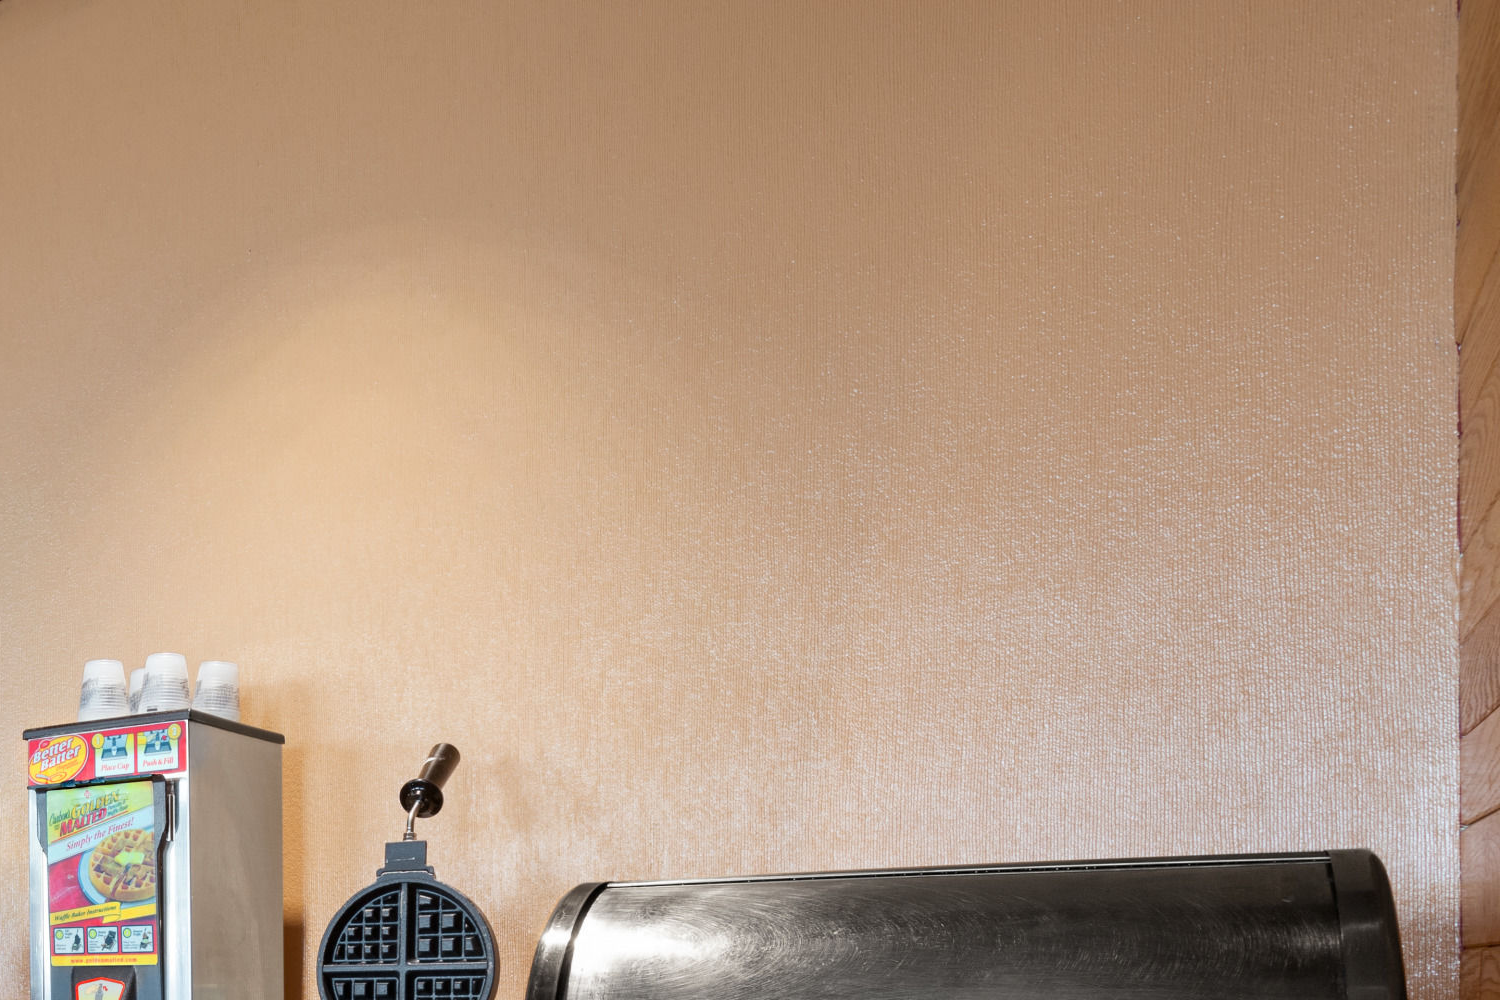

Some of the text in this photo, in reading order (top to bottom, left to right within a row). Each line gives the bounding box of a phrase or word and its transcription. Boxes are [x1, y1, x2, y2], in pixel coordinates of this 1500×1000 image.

[32, 737, 74, 765] Better
[40, 745, 81, 772] Batter
[142, 759, 158, 767] Push
[163, 757, 174, 765] Fill
[101, 762, 130, 771] Place Cup
[71, 791, 119, 819] GOLDEN
[60, 808, 108, 836] MALTED
[66, 817, 134, 851] Simply the Finest!
[54, 913, 71, 921] Waffle
[87, 905, 117, 915] Instructions
